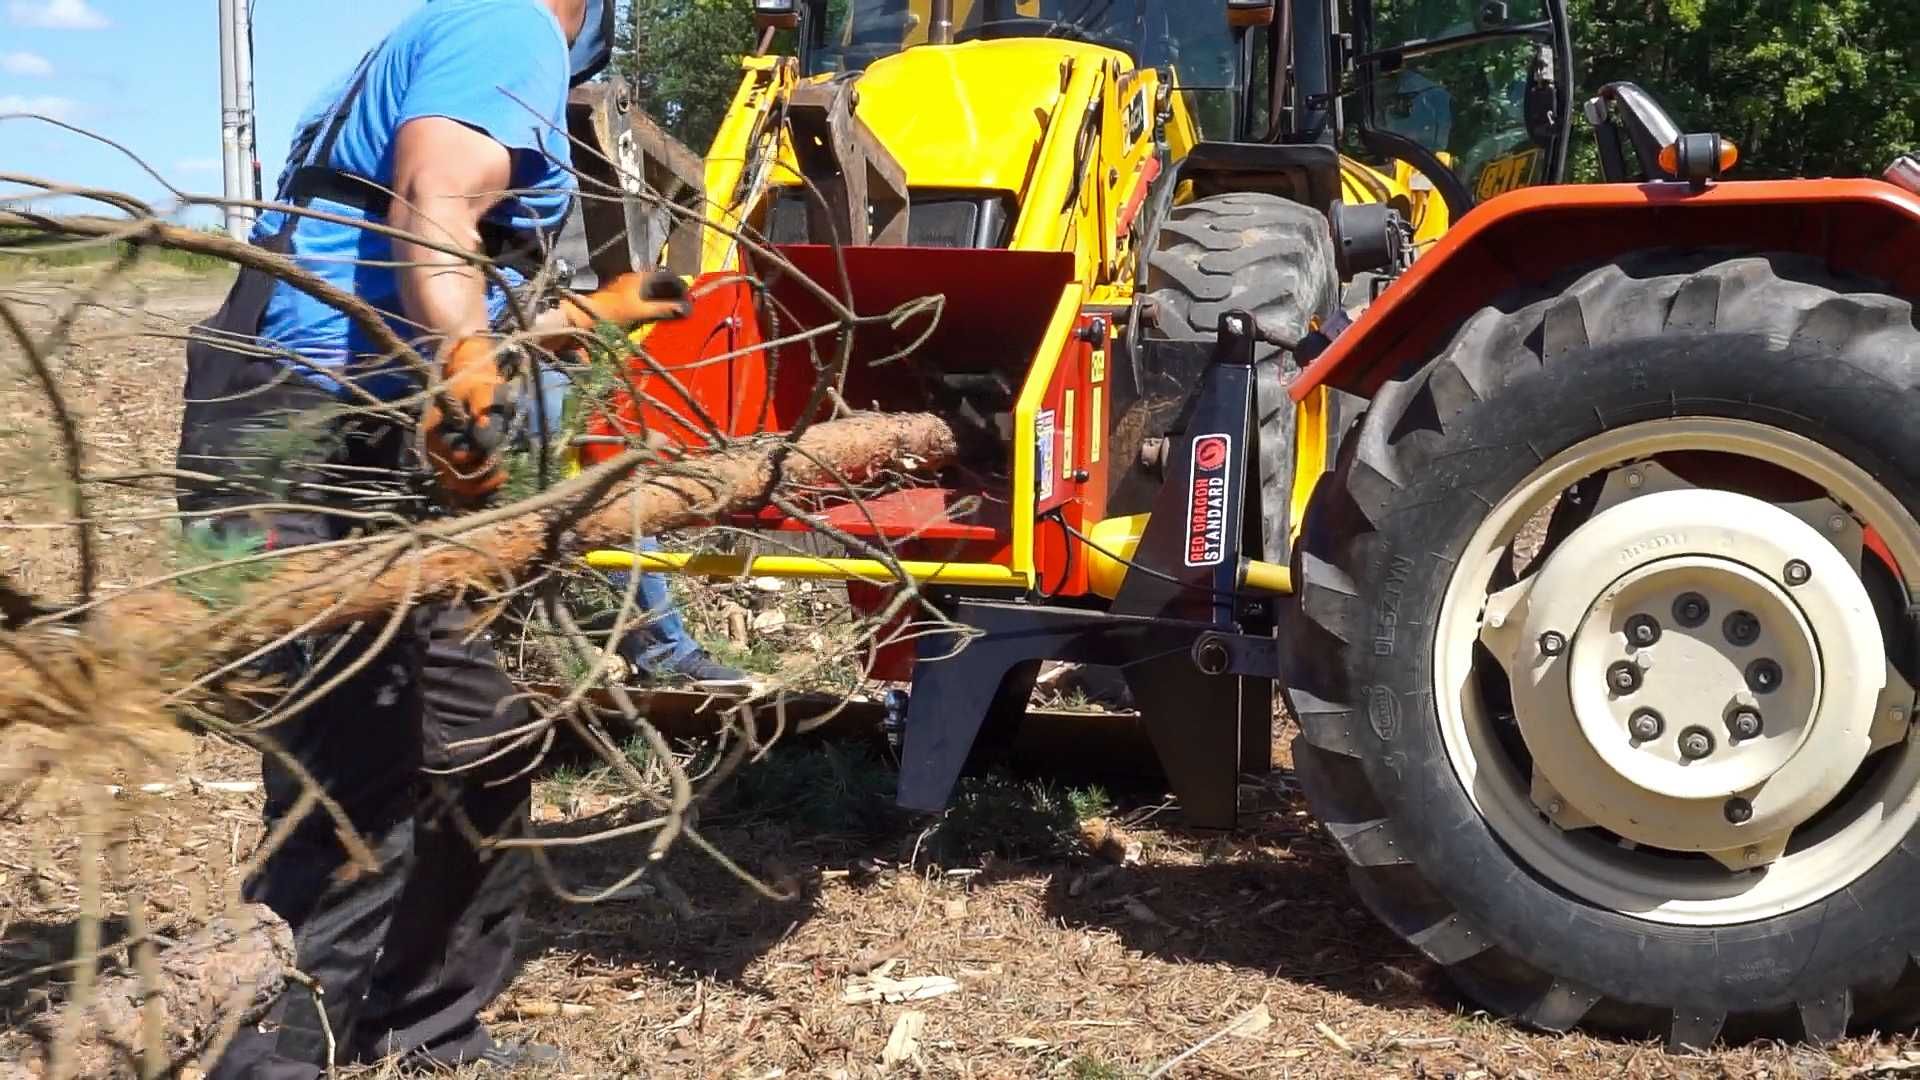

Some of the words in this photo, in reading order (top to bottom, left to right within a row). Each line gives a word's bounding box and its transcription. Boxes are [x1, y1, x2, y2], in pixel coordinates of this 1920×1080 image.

[1193, 478, 1209, 533] DRAGON
[1204, 477, 1224, 560] STANDARD
[1190, 537, 1206, 560] RED
